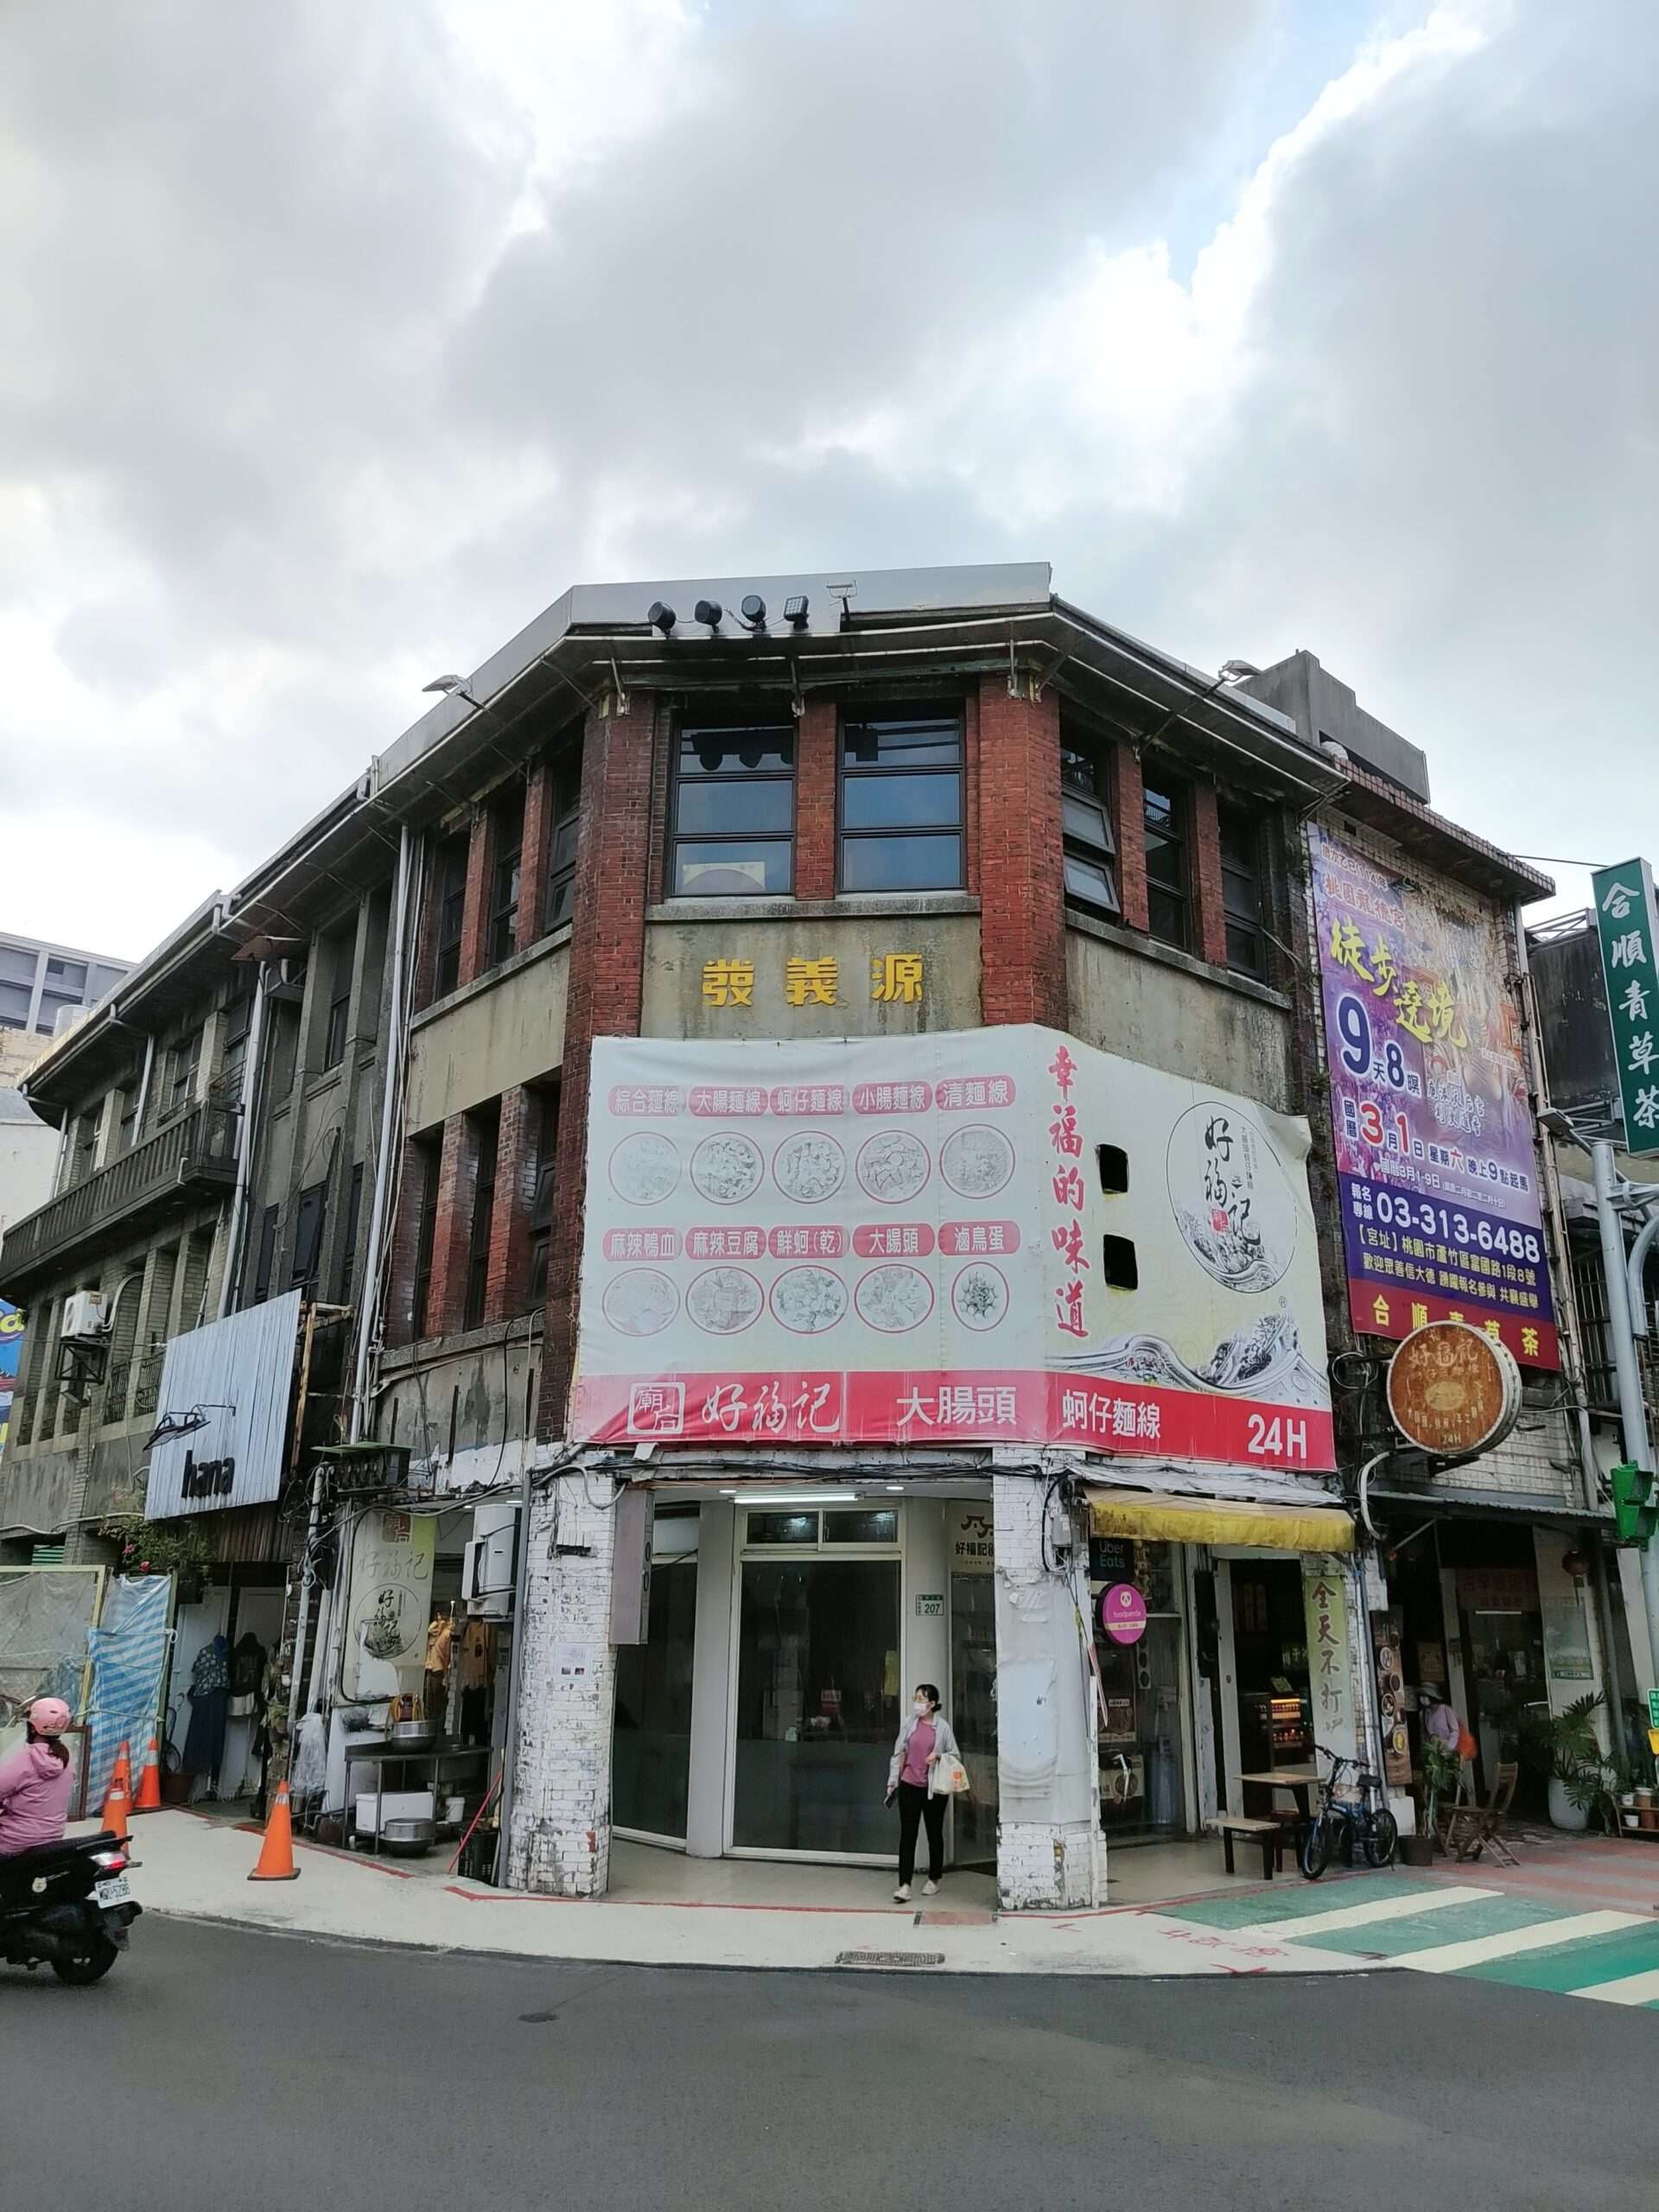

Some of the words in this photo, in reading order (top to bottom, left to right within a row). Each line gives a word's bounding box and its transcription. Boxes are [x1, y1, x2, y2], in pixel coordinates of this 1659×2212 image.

[614, 1089, 679, 1114] 綜合麵線
[696, 1090, 761, 1114] 大腸麵線
[778, 1088, 843, 1113] 蚵仔麵線
[858, 1084, 926, 1111] 小腸麵線
[944, 1078, 1009, 1107] 清麵線
[1049, 1044, 1090, 1338] 幸福的味道
[869, 1228, 919, 1254] 大腸頭
[1376, 1192, 1541, 1264] 03-313-6488
[611, 1231, 676, 1259] 麻辣鴨血
[692, 1230, 760, 1255] 麻辣豆腐
[896, 1386, 1017, 1427] 大腸頭
[1062, 1389, 1161, 1440] 蚵仔麵線
[1248, 1414, 1306, 1459] 24H
[1099, 1540, 1124, 1554] Uber
[1099, 1555, 1126, 1568] Eats
[924, 1603, 941, 1614] 207
